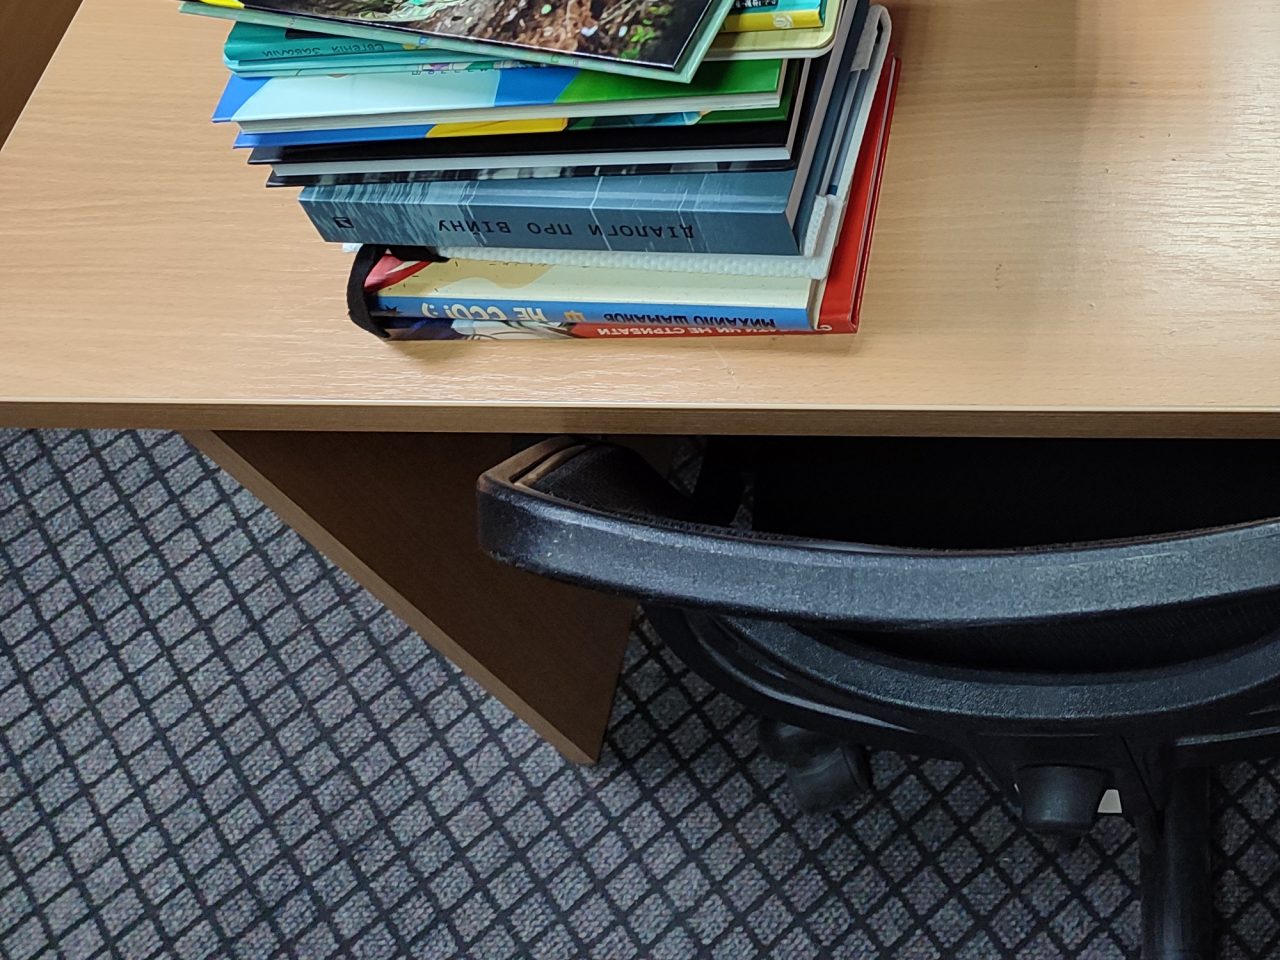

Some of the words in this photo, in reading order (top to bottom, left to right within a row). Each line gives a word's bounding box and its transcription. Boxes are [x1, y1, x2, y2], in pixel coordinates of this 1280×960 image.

[437, 218, 512, 238] ВІЙНУ
[526, 221, 573, 237] ПРО
[586, 223, 695, 240] ДІАЛОГИ
[513, 305, 546, 323] НЕ
[597, 326, 682, 338] СТРИБАТИ
